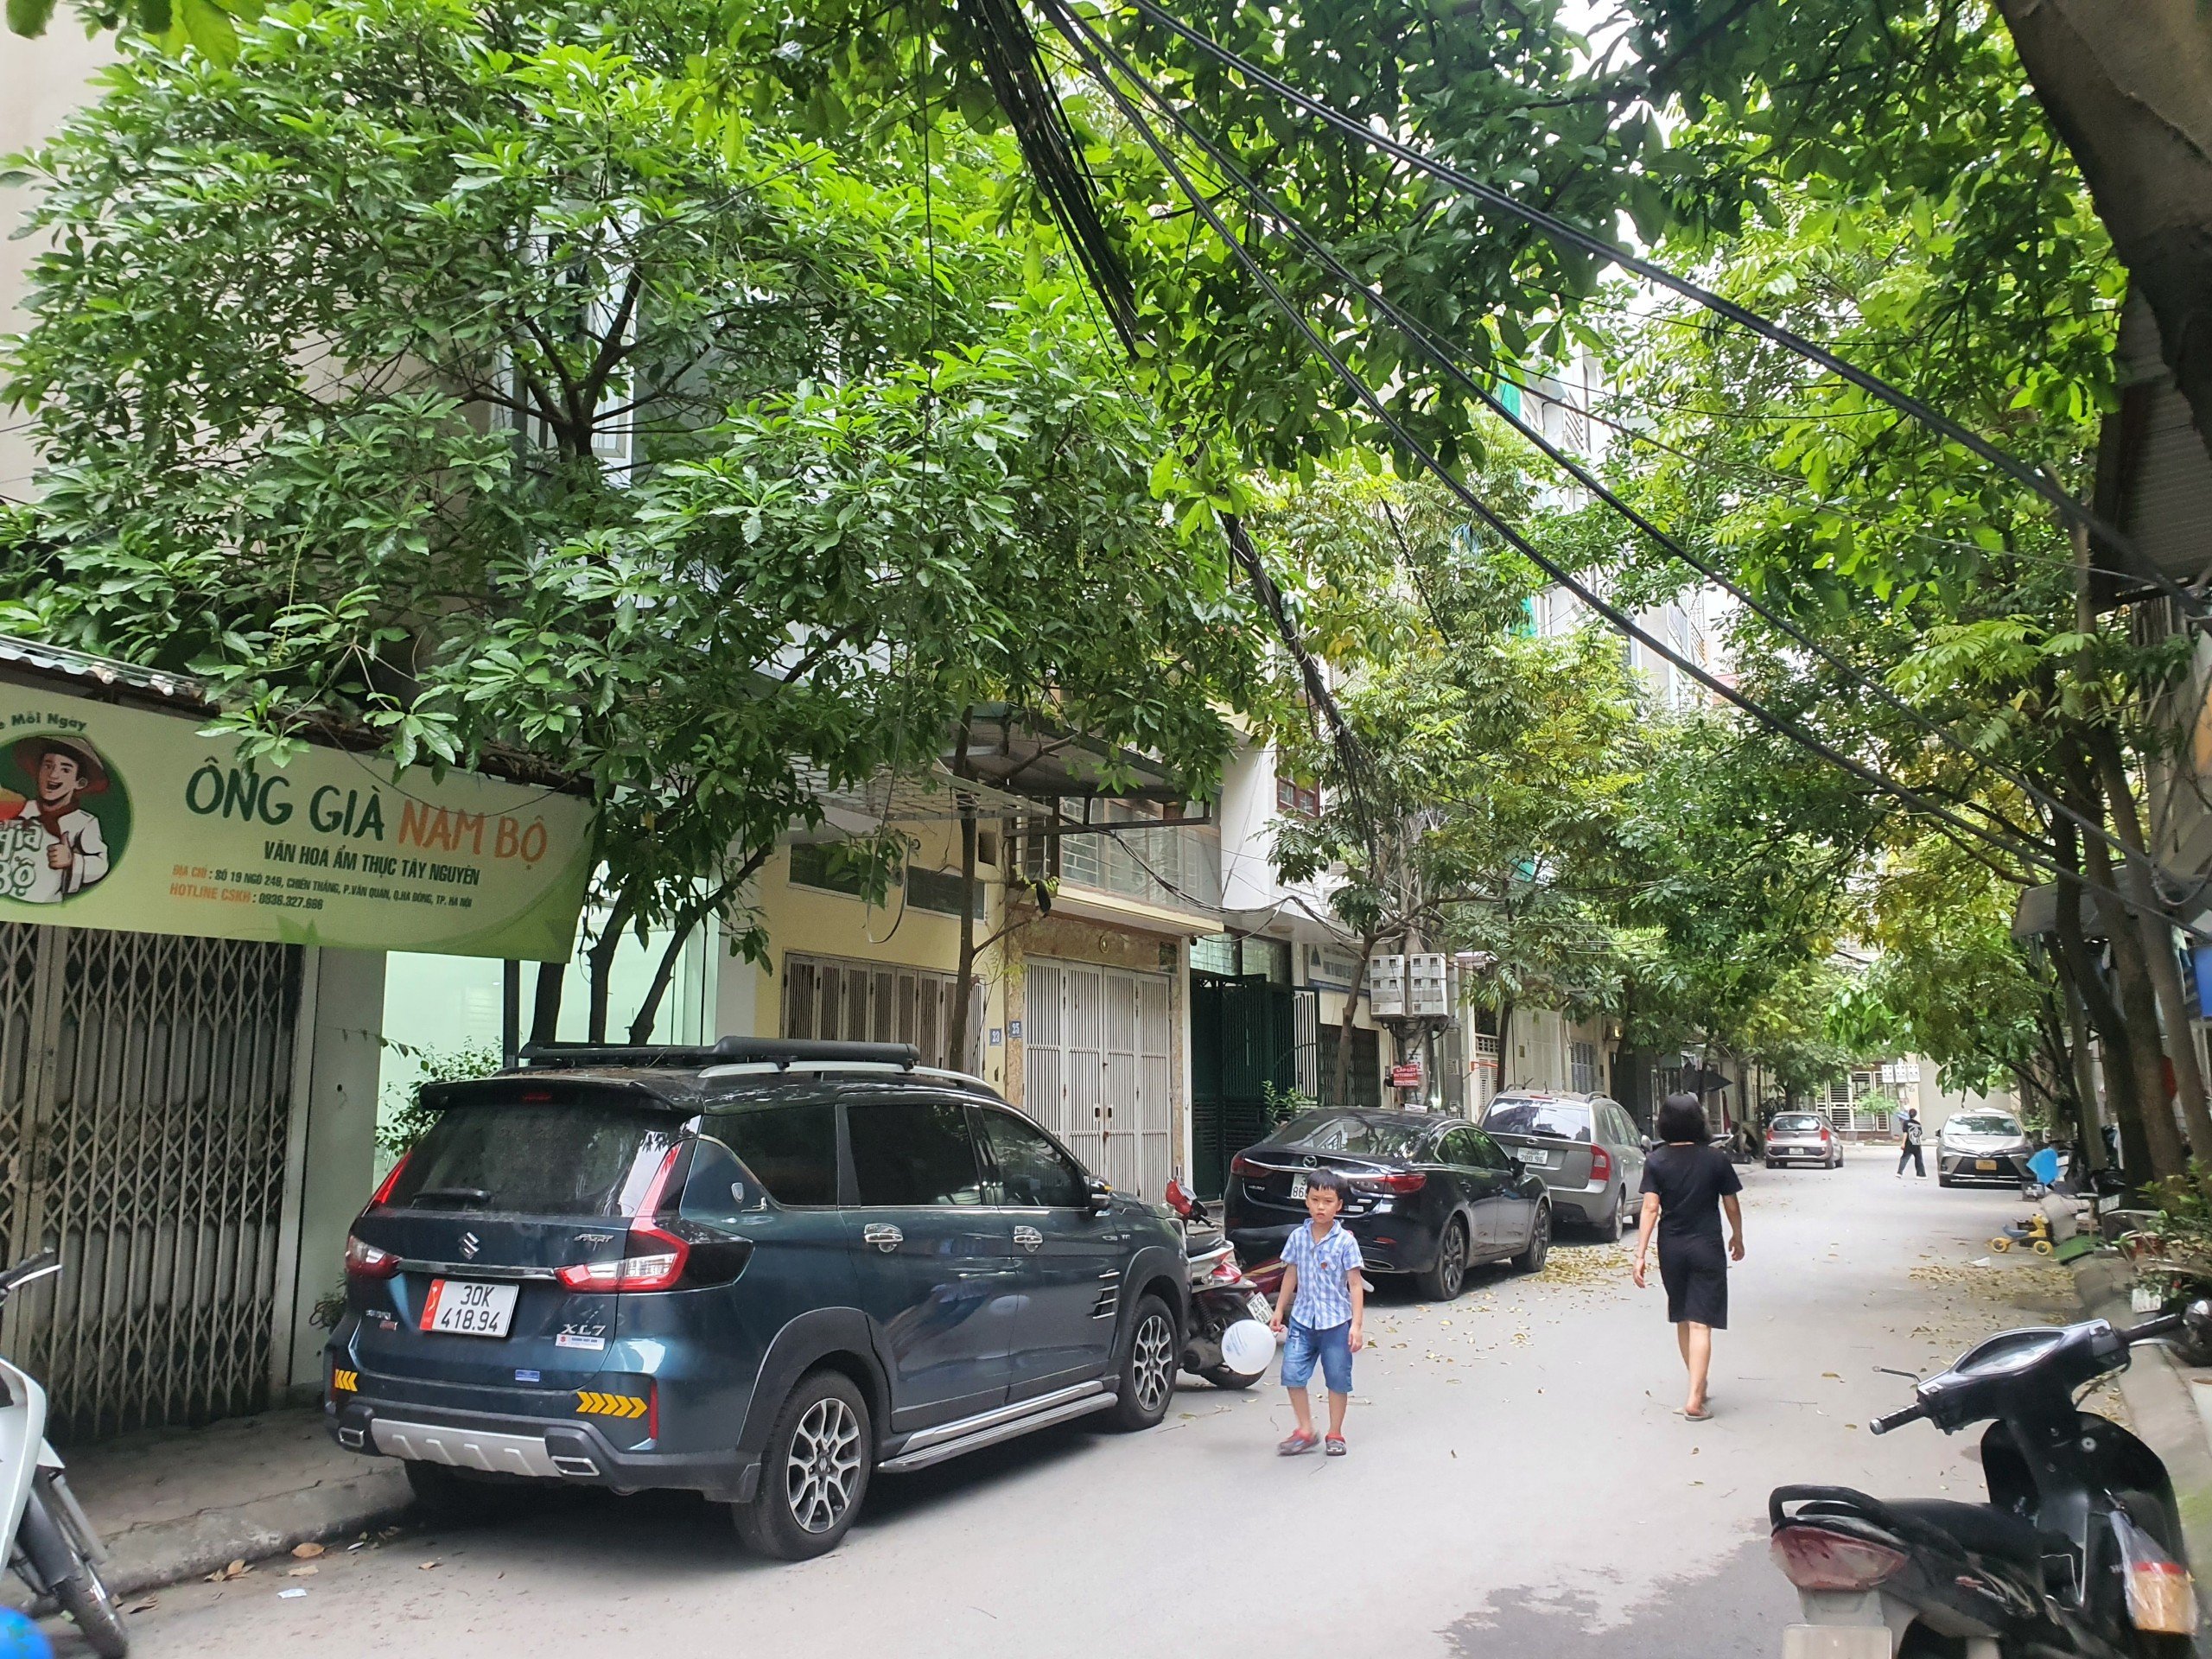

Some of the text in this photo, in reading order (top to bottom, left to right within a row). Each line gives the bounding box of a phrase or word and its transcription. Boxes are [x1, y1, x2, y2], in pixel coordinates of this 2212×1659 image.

[185, 755, 547, 870] ÔNG GIÀ NAM BỘ
[264, 839, 481, 886] VĂN HOÁ ẨM THỤC TÂY NGUYÊN
[231, 871, 243, 883] 19
[169, 882, 219, 900] HOTLINE
[221, 887, 251, 903] CSKH
[992, 1030, 1001, 1043] 23
[1012, 1022, 1020, 1034] 25
[460, 1284, 495, 1308] 30K
[441, 1307, 500, 1332] 418.94
[560, 1323, 607, 1337] XL7
